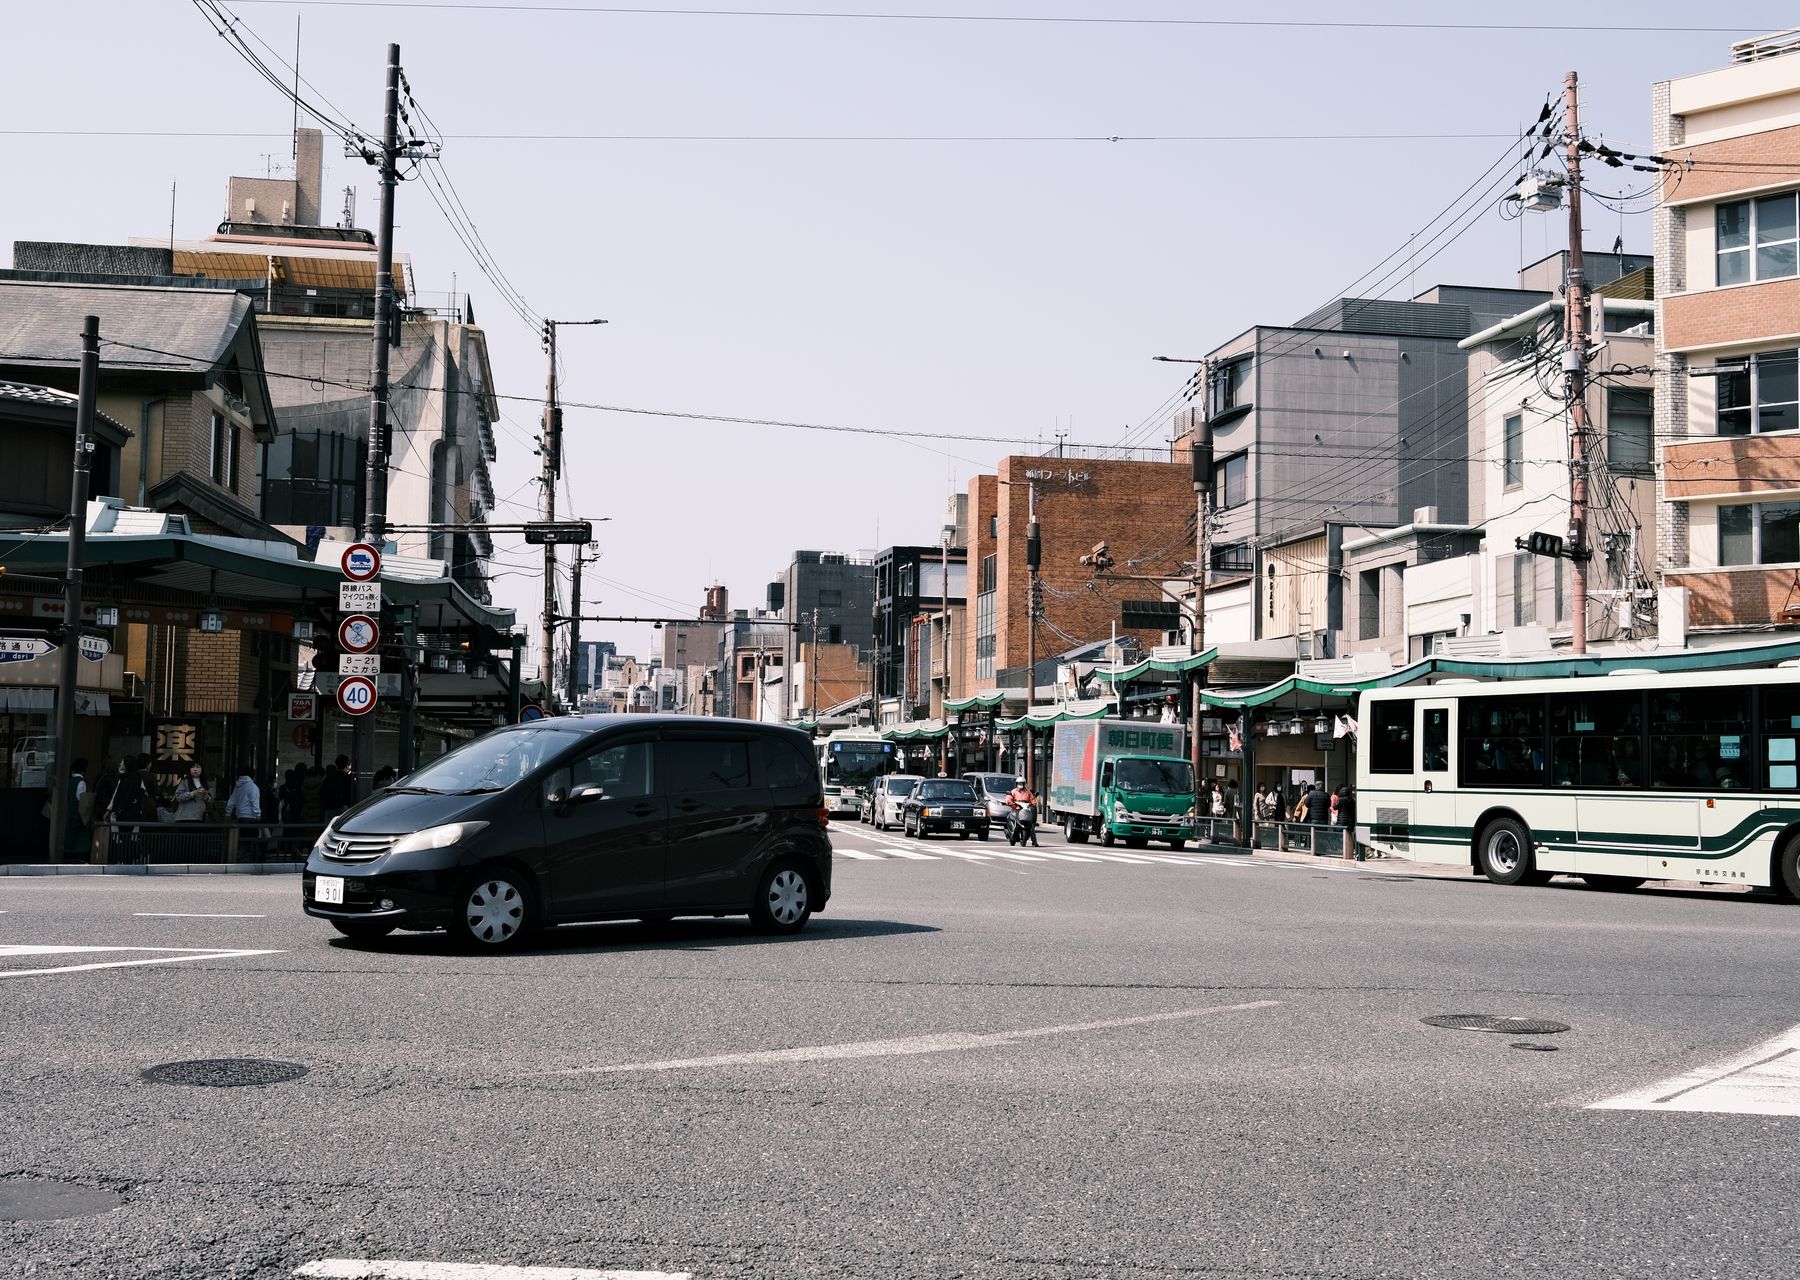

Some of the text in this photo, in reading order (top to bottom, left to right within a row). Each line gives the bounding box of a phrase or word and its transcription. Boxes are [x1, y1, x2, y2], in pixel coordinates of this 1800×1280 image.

[341, 665, 379, 673] ここから
[346, 687, 368, 704] 40
[156, 724, 196, 761] 薬
